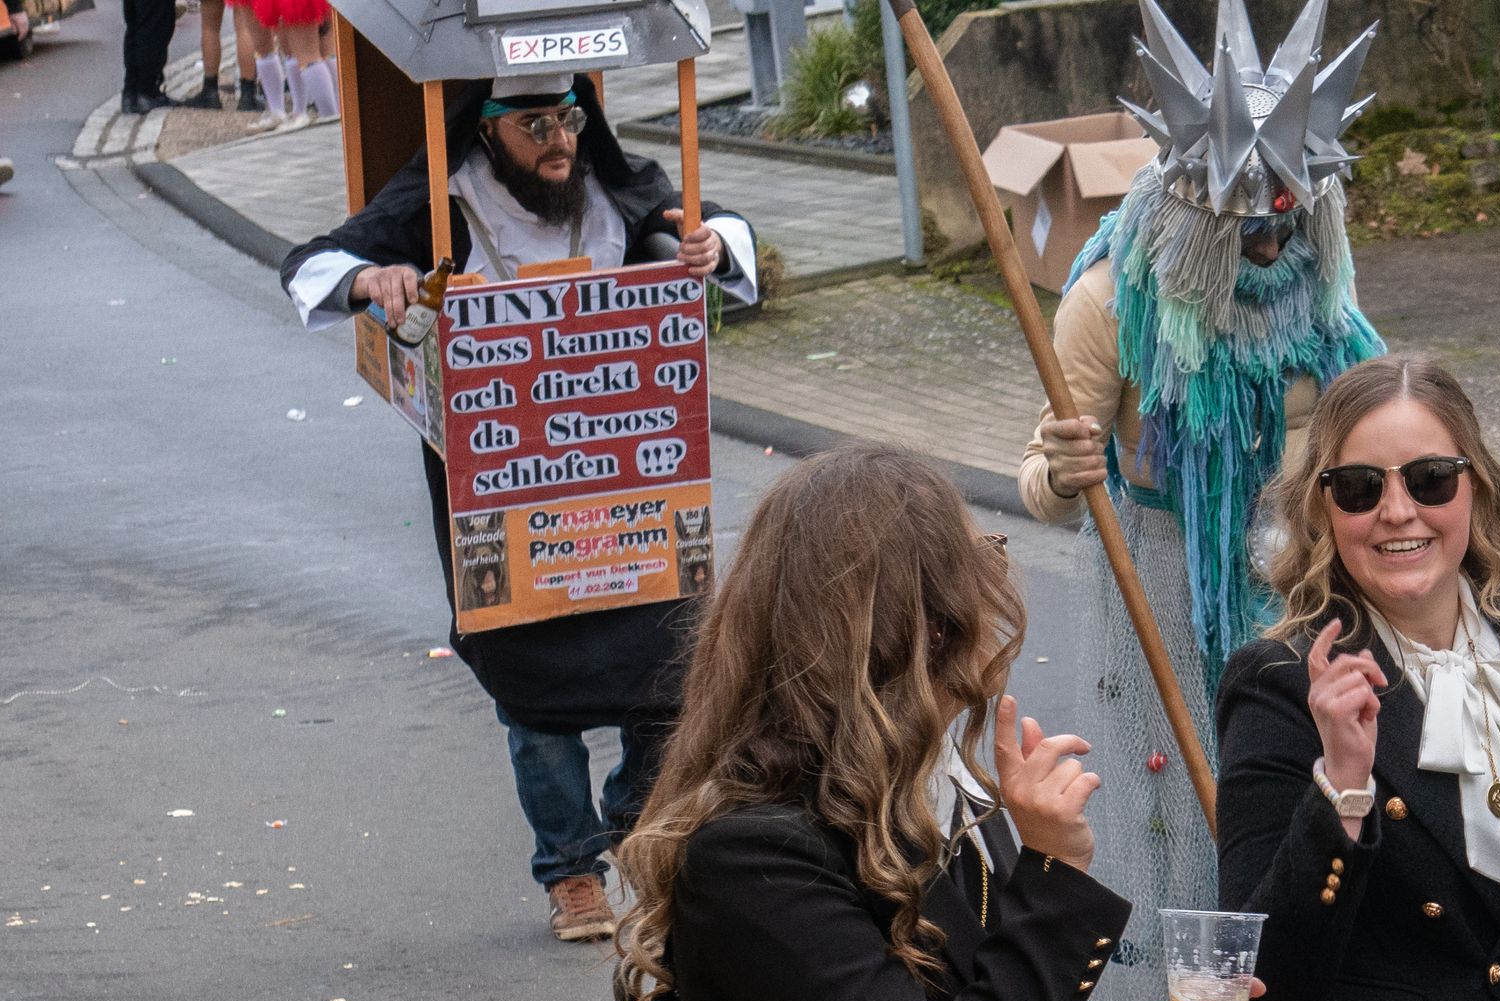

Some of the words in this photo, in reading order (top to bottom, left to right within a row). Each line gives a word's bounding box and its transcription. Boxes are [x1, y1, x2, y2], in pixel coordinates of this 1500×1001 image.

[509, 31, 623, 60] EXPRESS
[447, 285, 565, 329] TINY
[577, 280, 700, 314] House
[451, 337, 529, 367] Soss
[545, 326, 649, 358] kanns
[661, 316, 700, 344] de
[453, 380, 515, 412] och
[532, 364, 639, 401] direkt
[657, 361, 698, 390] op
[473, 421, 517, 449] da
[549, 408, 676, 443] Strooss
[475, 453, 619, 493] schlofen
[642, 443, 683, 475] !!?
[469, 514, 491, 527] Joer
[528, 499, 667, 533] Ornaneyer
[455, 528, 506, 548] Cavalcade
[529, 527, 668, 561] Programm
[535, 571, 581, 585] Rapport
[586, 567, 607, 578] vun
